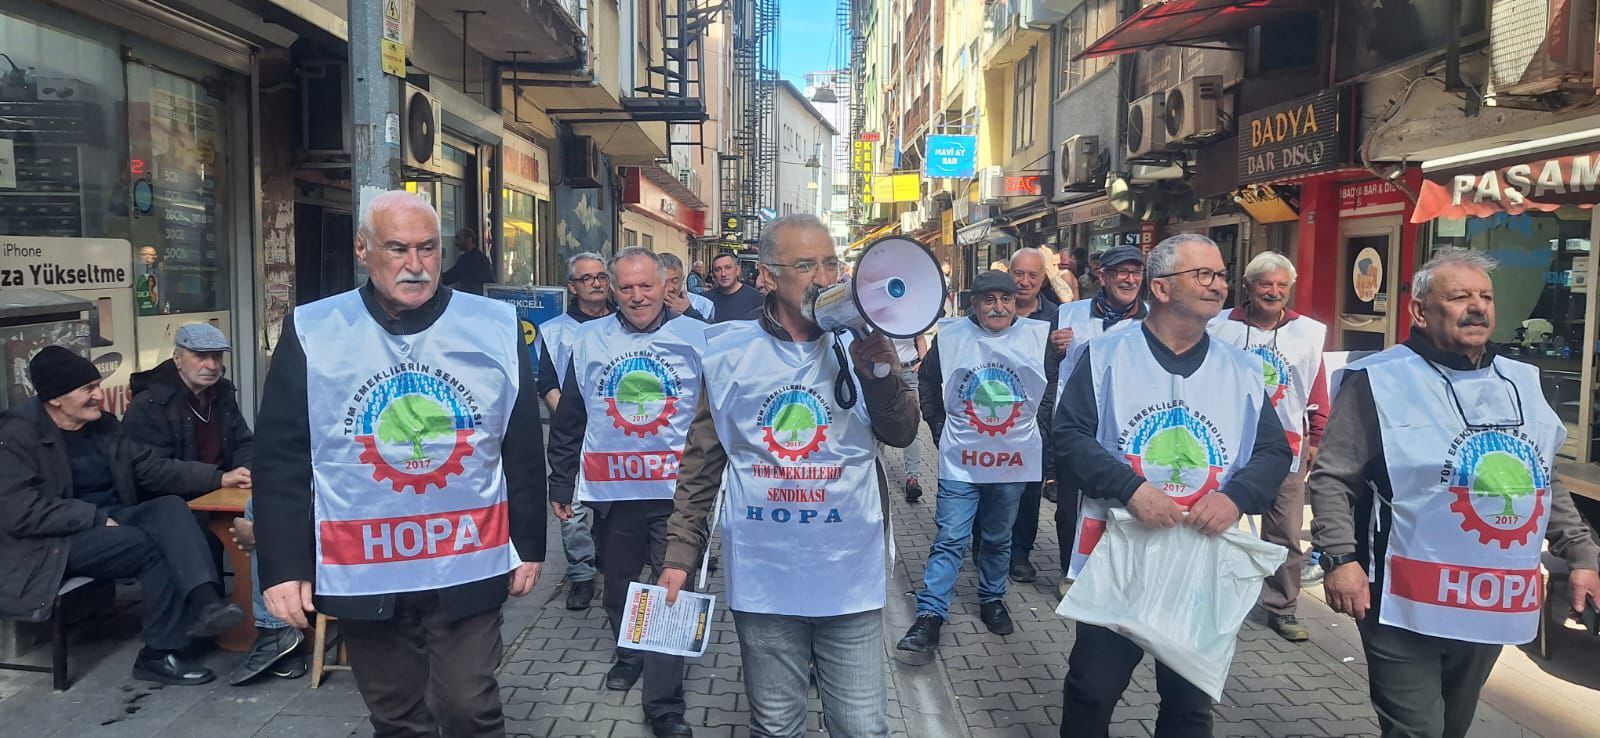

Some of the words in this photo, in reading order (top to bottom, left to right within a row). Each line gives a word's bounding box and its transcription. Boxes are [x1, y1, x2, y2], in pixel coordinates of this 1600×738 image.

[1251, 103, 1318, 148] BADYA
[854, 141, 862, 170] OTEL
[1248, 151, 1275, 175] BAR
[1283, 140, 1324, 168] DISCO
[1006, 176, 1040, 193] SAÇ
[1363, 184, 1378, 196] BAR
[1452, 153, 1600, 206] PAŞAM
[2, 243, 42, 258] iPhone
[29, 263, 125, 285] Yükseltme
[603, 350, 653, 376] EMEKLİLERİN
[354, 362, 430, 403] EMEKLİLERİN
[434, 368, 483, 426] SENDİKASI
[1193, 409, 1230, 466] SENDİKASI
[405, 459, 431, 470] 2017
[607, 453, 680, 479] HOPA
[961, 449, 1024, 468] HOPA
[751, 460, 771, 479] TÜM
[773, 463, 844, 481] EMEKLİLERİN
[767, 485, 825, 502] SENDİKASI
[1163, 482, 1186, 493] 2017
[745, 505, 843, 524] HOPA
[1495, 515, 1518, 525] 2017
[361, 514, 483, 560] HOPA
[1437, 567, 1539, 608] HOPA
